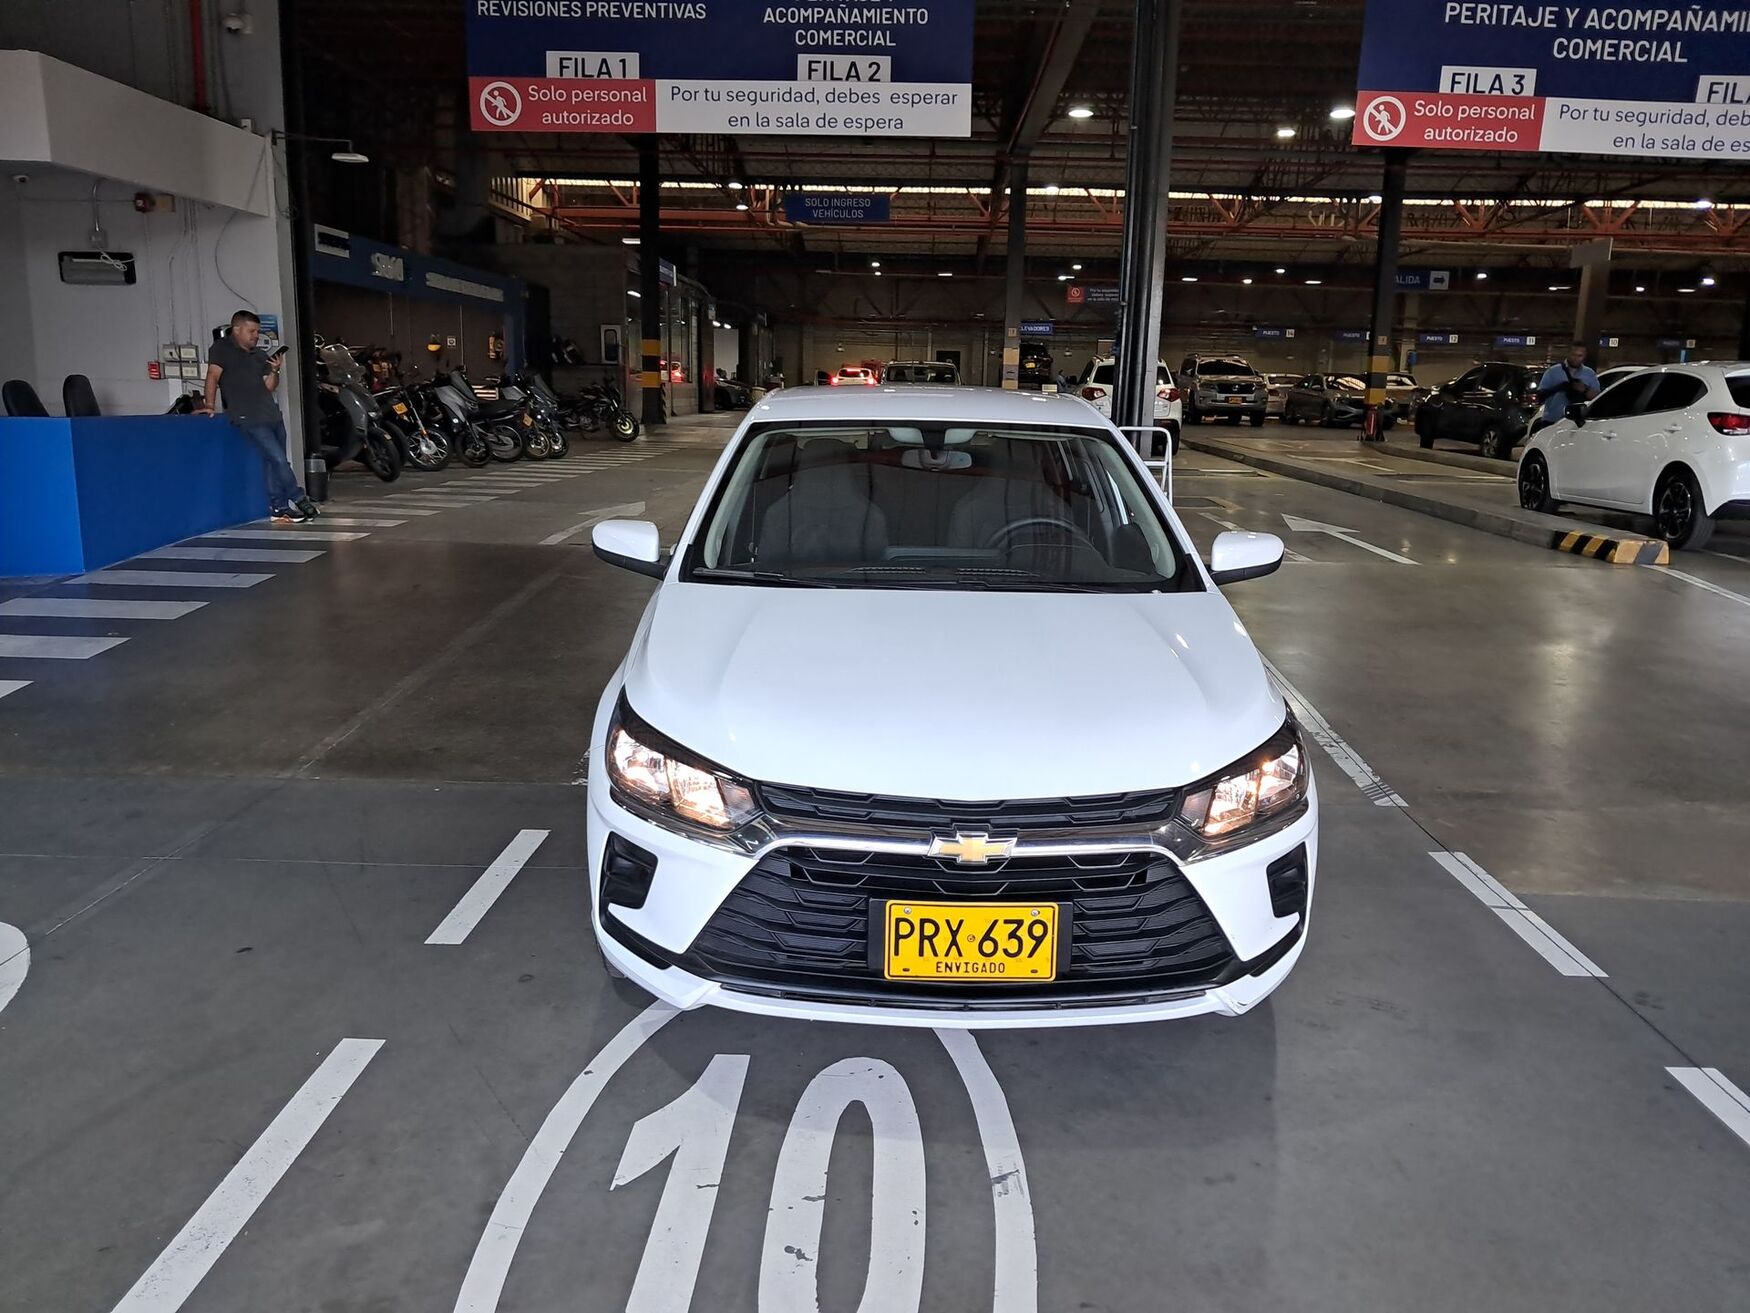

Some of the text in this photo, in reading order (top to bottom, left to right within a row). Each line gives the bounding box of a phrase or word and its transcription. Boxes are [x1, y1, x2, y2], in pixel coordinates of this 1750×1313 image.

[478, 1, 706, 19] REVISIONES PREVENTIVAS
[763, 4, 928, 25] ACOMPAÑAMIENTO
[1445, 2, 1559, 28] PERITAJE
[1566, 7, 1580, 28] Y
[795, 30, 896, 46] COMERCIAL
[1553, 37, 1688, 62] COMERCIAL
[559, 57, 627, 78] FILA 1
[807, 60, 881, 82] FILA 2
[1450, 72, 1526, 95] FILA 3
[528, 86, 647, 104] Solo personal
[671, 86, 957, 107] Por tu seguridad, debes esperar
[542, 110, 634, 125] autorizado
[1414, 100, 1536, 120] Solo personal
[1559, 105, 1590, 121] Por
[1593, 107, 1611, 122] tu
[1615, 108, 1710, 128] seguridad,
[728, 112, 904, 132] en la sala de espera
[1424, 126, 1518, 142] autorizado
[1613, 135, 1635, 149] en
[1640, 133, 1657, 150] la
[1661, 134, 1696, 151] sala
[1702, 136, 1725, 151] de
[805, 198, 871, 207] SOLO INGRESO
[812, 208, 864, 218] VEHÍCULOS
[893, 917, 1049, 959] PRX 639
[935, 961, 1006, 974] ENVIGADO
[610, 1054, 926, 1313] 10
